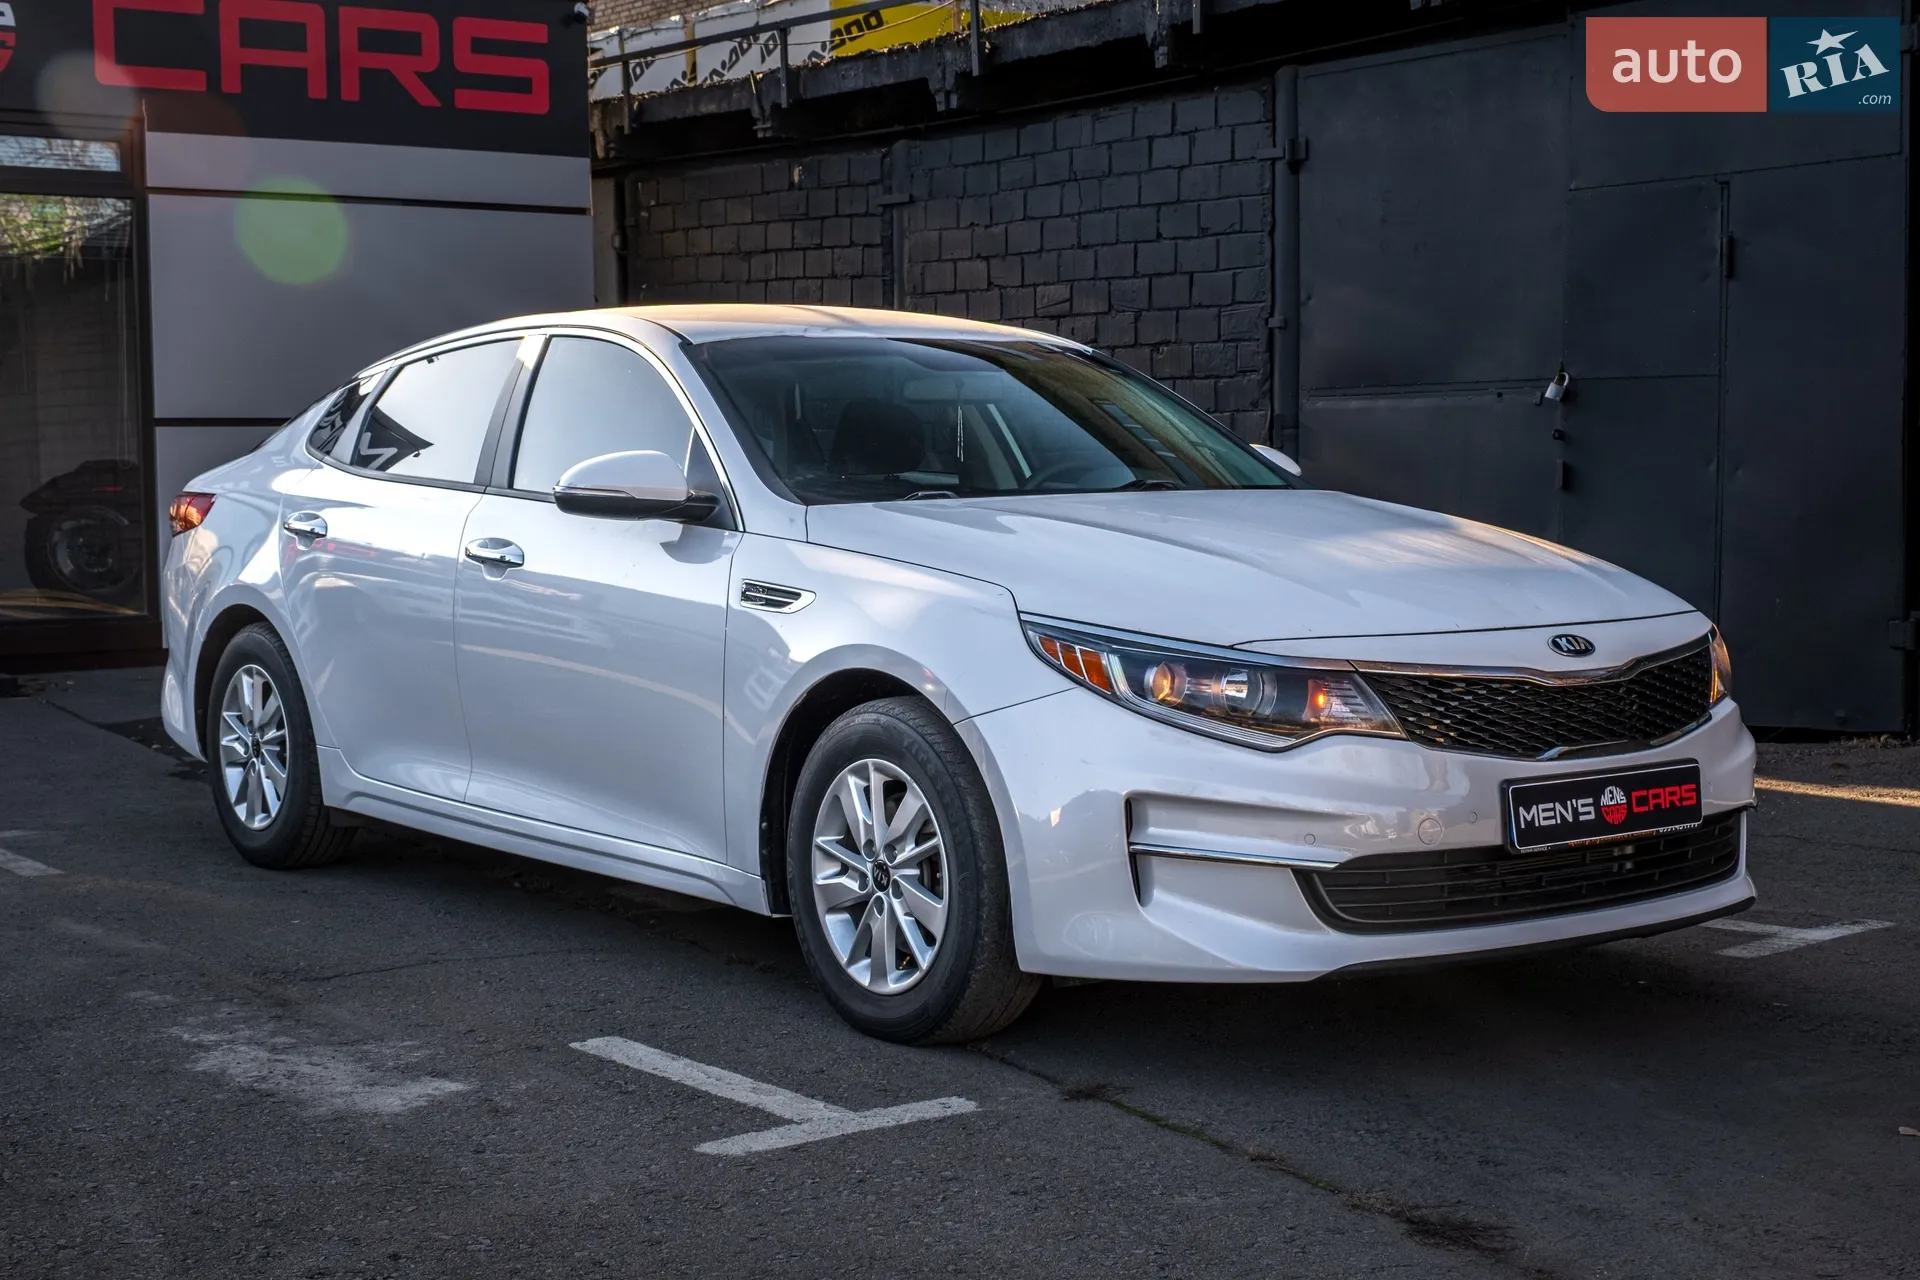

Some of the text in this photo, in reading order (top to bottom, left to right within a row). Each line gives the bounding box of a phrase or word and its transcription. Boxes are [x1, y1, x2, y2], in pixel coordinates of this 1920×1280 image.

[93, 0, 550, 114] CARS
[1554, 636, 1593, 651] KIA
[1519, 783, 1698, 829] MEN'S CARS
